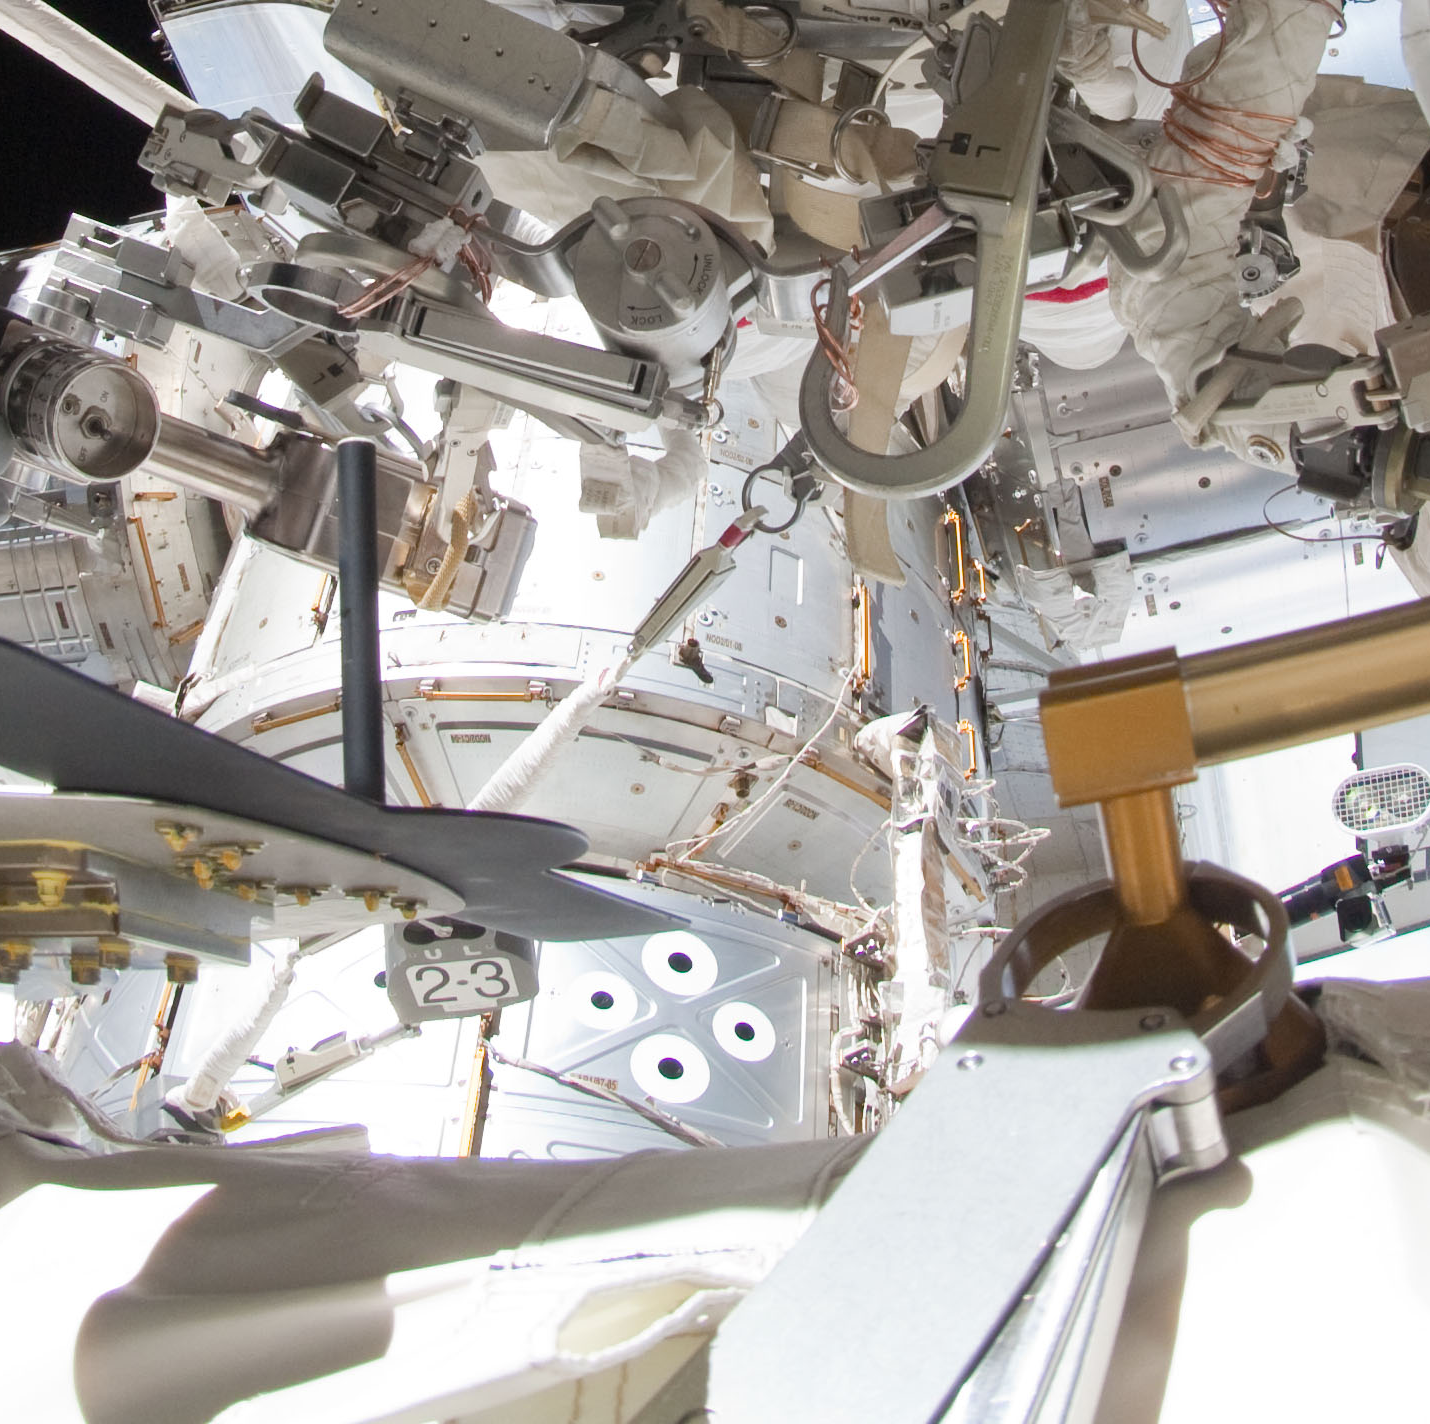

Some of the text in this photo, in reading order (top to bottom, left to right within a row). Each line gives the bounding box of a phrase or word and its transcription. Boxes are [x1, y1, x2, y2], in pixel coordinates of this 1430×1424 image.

[694, 254, 714, 296] UNLOCK
[630, 314, 663, 326] LOCK
[415, 959, 511, 1004] 2-3
